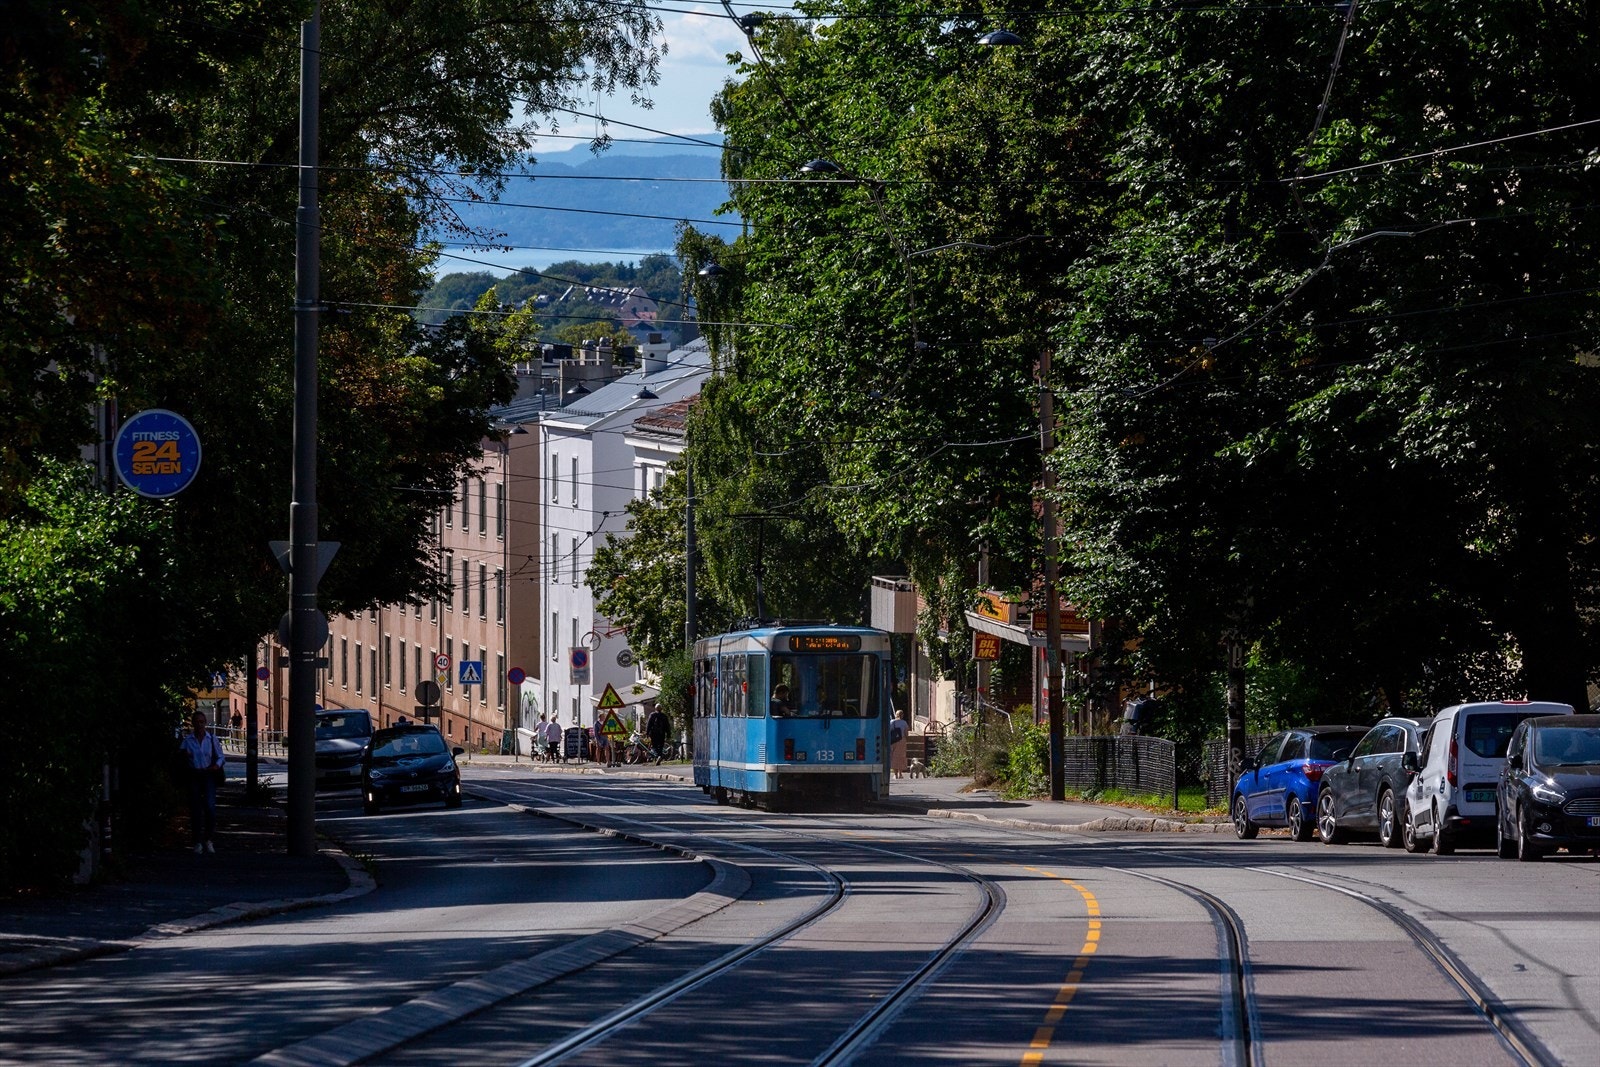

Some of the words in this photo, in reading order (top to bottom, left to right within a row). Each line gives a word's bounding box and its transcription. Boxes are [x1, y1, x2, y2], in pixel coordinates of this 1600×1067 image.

[132, 431, 180, 441] FITNESS
[132, 441, 181, 462] 24
[132, 462, 181, 475] SEVEN
[979, 640, 996, 649] BIL
[977, 649, 997, 658] MC
[437, 658, 448, 667] 40
[816, 750, 835, 761] 133
